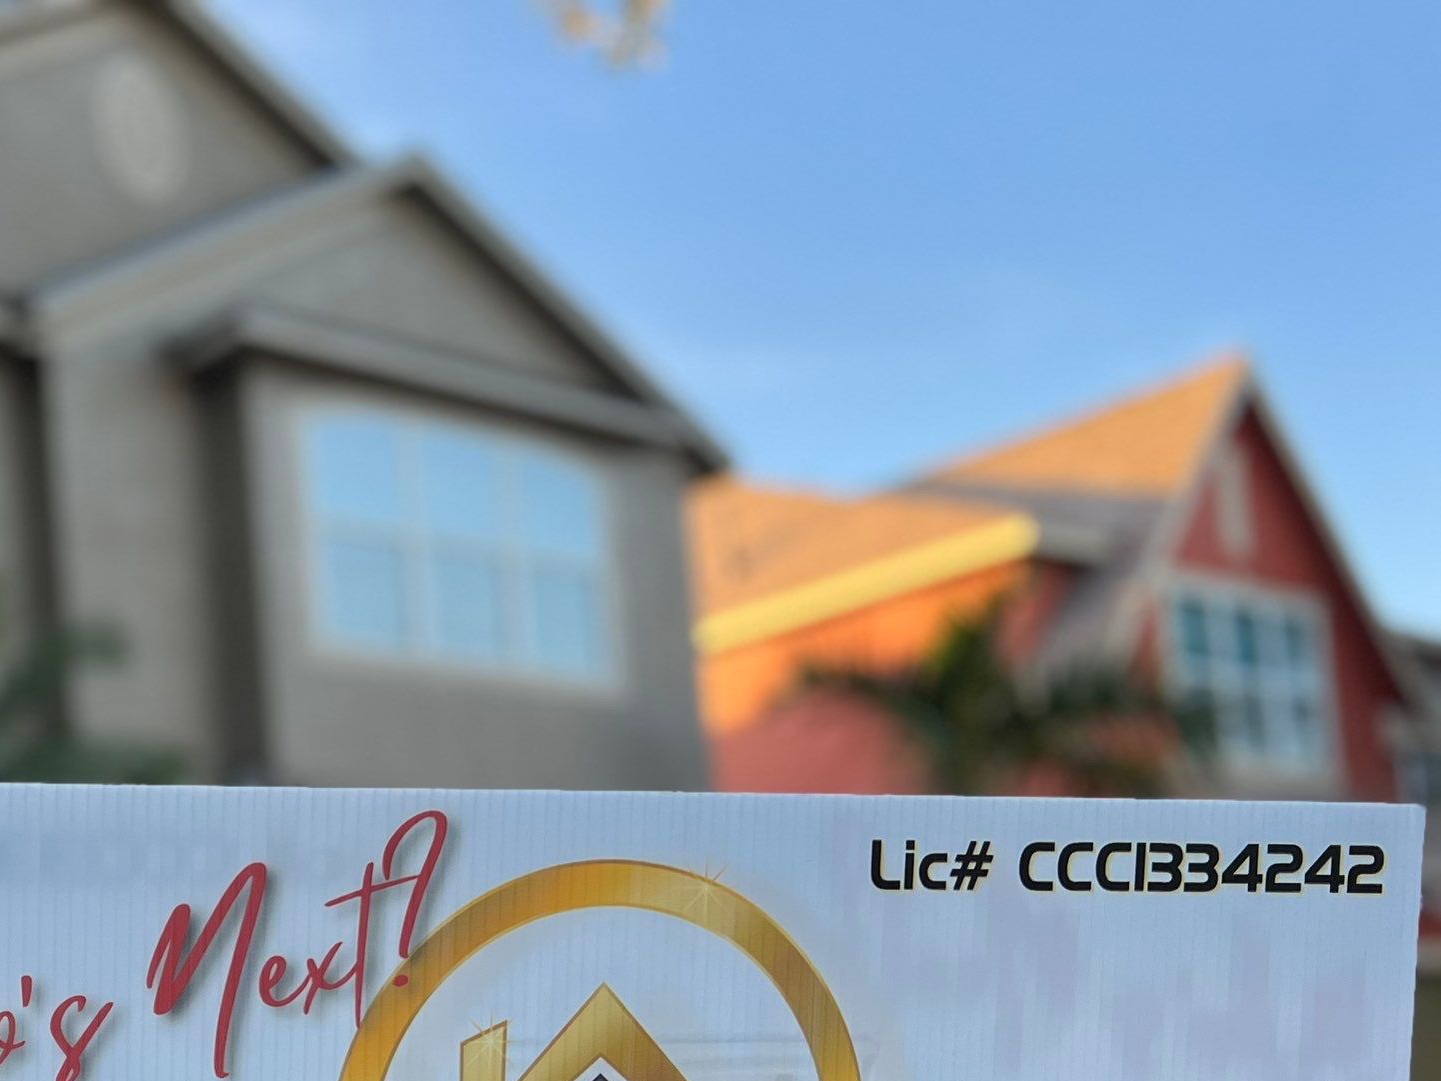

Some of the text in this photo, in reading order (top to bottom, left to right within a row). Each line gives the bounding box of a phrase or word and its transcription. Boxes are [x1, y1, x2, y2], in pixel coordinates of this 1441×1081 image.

[146, 810, 448, 1078] Next?
[870, 839, 1384, 894] Lic# CCC1334242
